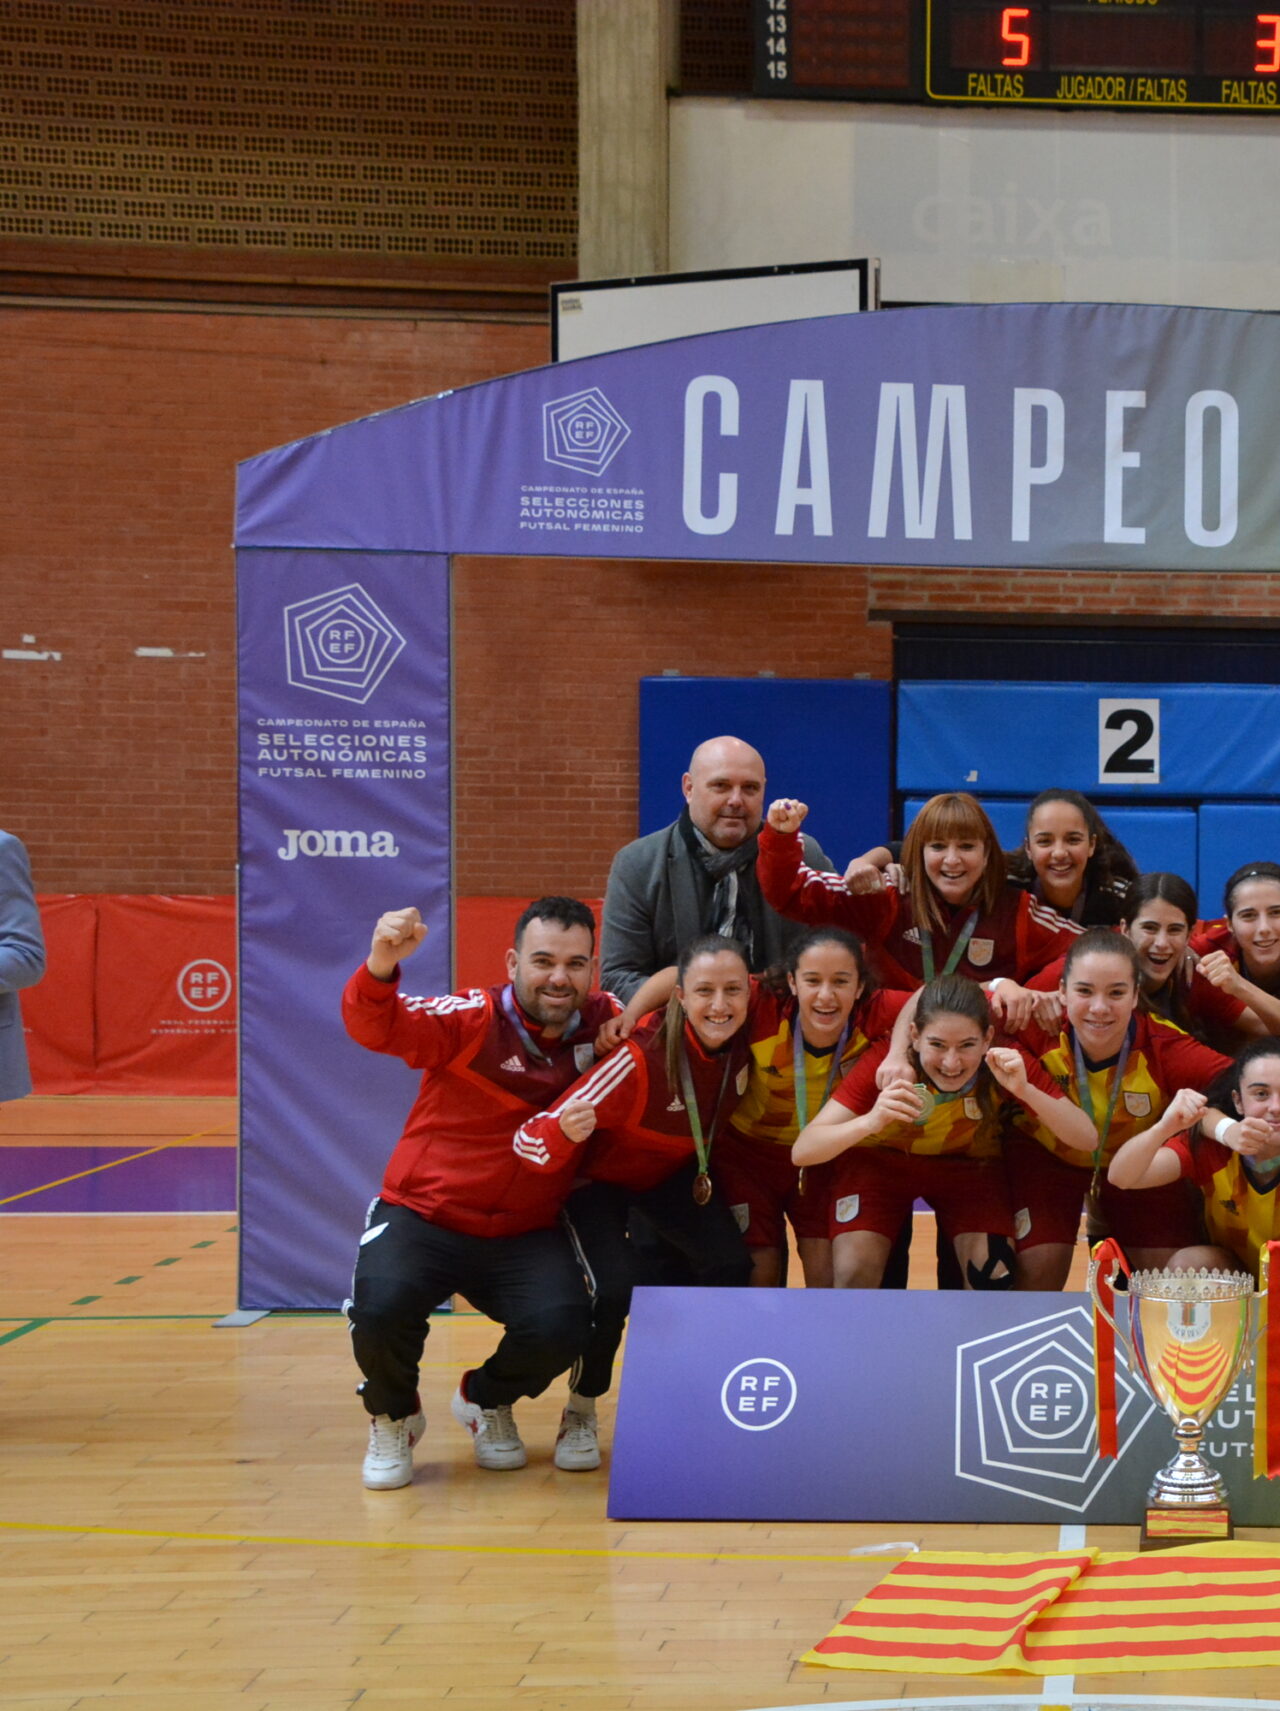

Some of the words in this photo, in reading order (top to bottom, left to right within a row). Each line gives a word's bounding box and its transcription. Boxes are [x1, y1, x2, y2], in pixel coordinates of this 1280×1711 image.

[767, 14, 787, 33] 13
[1001, 8, 1030, 66] 5
[766, 37, 787, 56] 14
[767, 61, 787, 79] 15
[967, 73, 1024, 97] FALTAS
[1056, 75, 1125, 99] JUGADOR
[1137, 78, 1187, 101] FALTAS
[1221, 80, 1278, 104] FALTAS
[520, 485, 588, 495] CAMPEONATO
[590, 487, 604, 495] DE
[605, 487, 644, 496] ESPAÑA
[520, 496, 645, 510] SELECCIONES
[519, 508, 645, 521] AUTONÓMICAS
[519, 522, 571, 531] FUTSAL
[574, 523, 643, 533] FEMENINO
[256, 718, 348, 728] CAMPEONATO
[352, 720, 370, 728] DE
[374, 718, 426, 728] ESPAÑA
[257, 733, 428, 748] SELECCIONES
[1103, 708, 1154, 773] 2
[257, 747, 428, 763] AUTONÓMICAS
[258, 767, 326, 778] FUTSAL
[332, 768, 426, 779] FEMENINO
